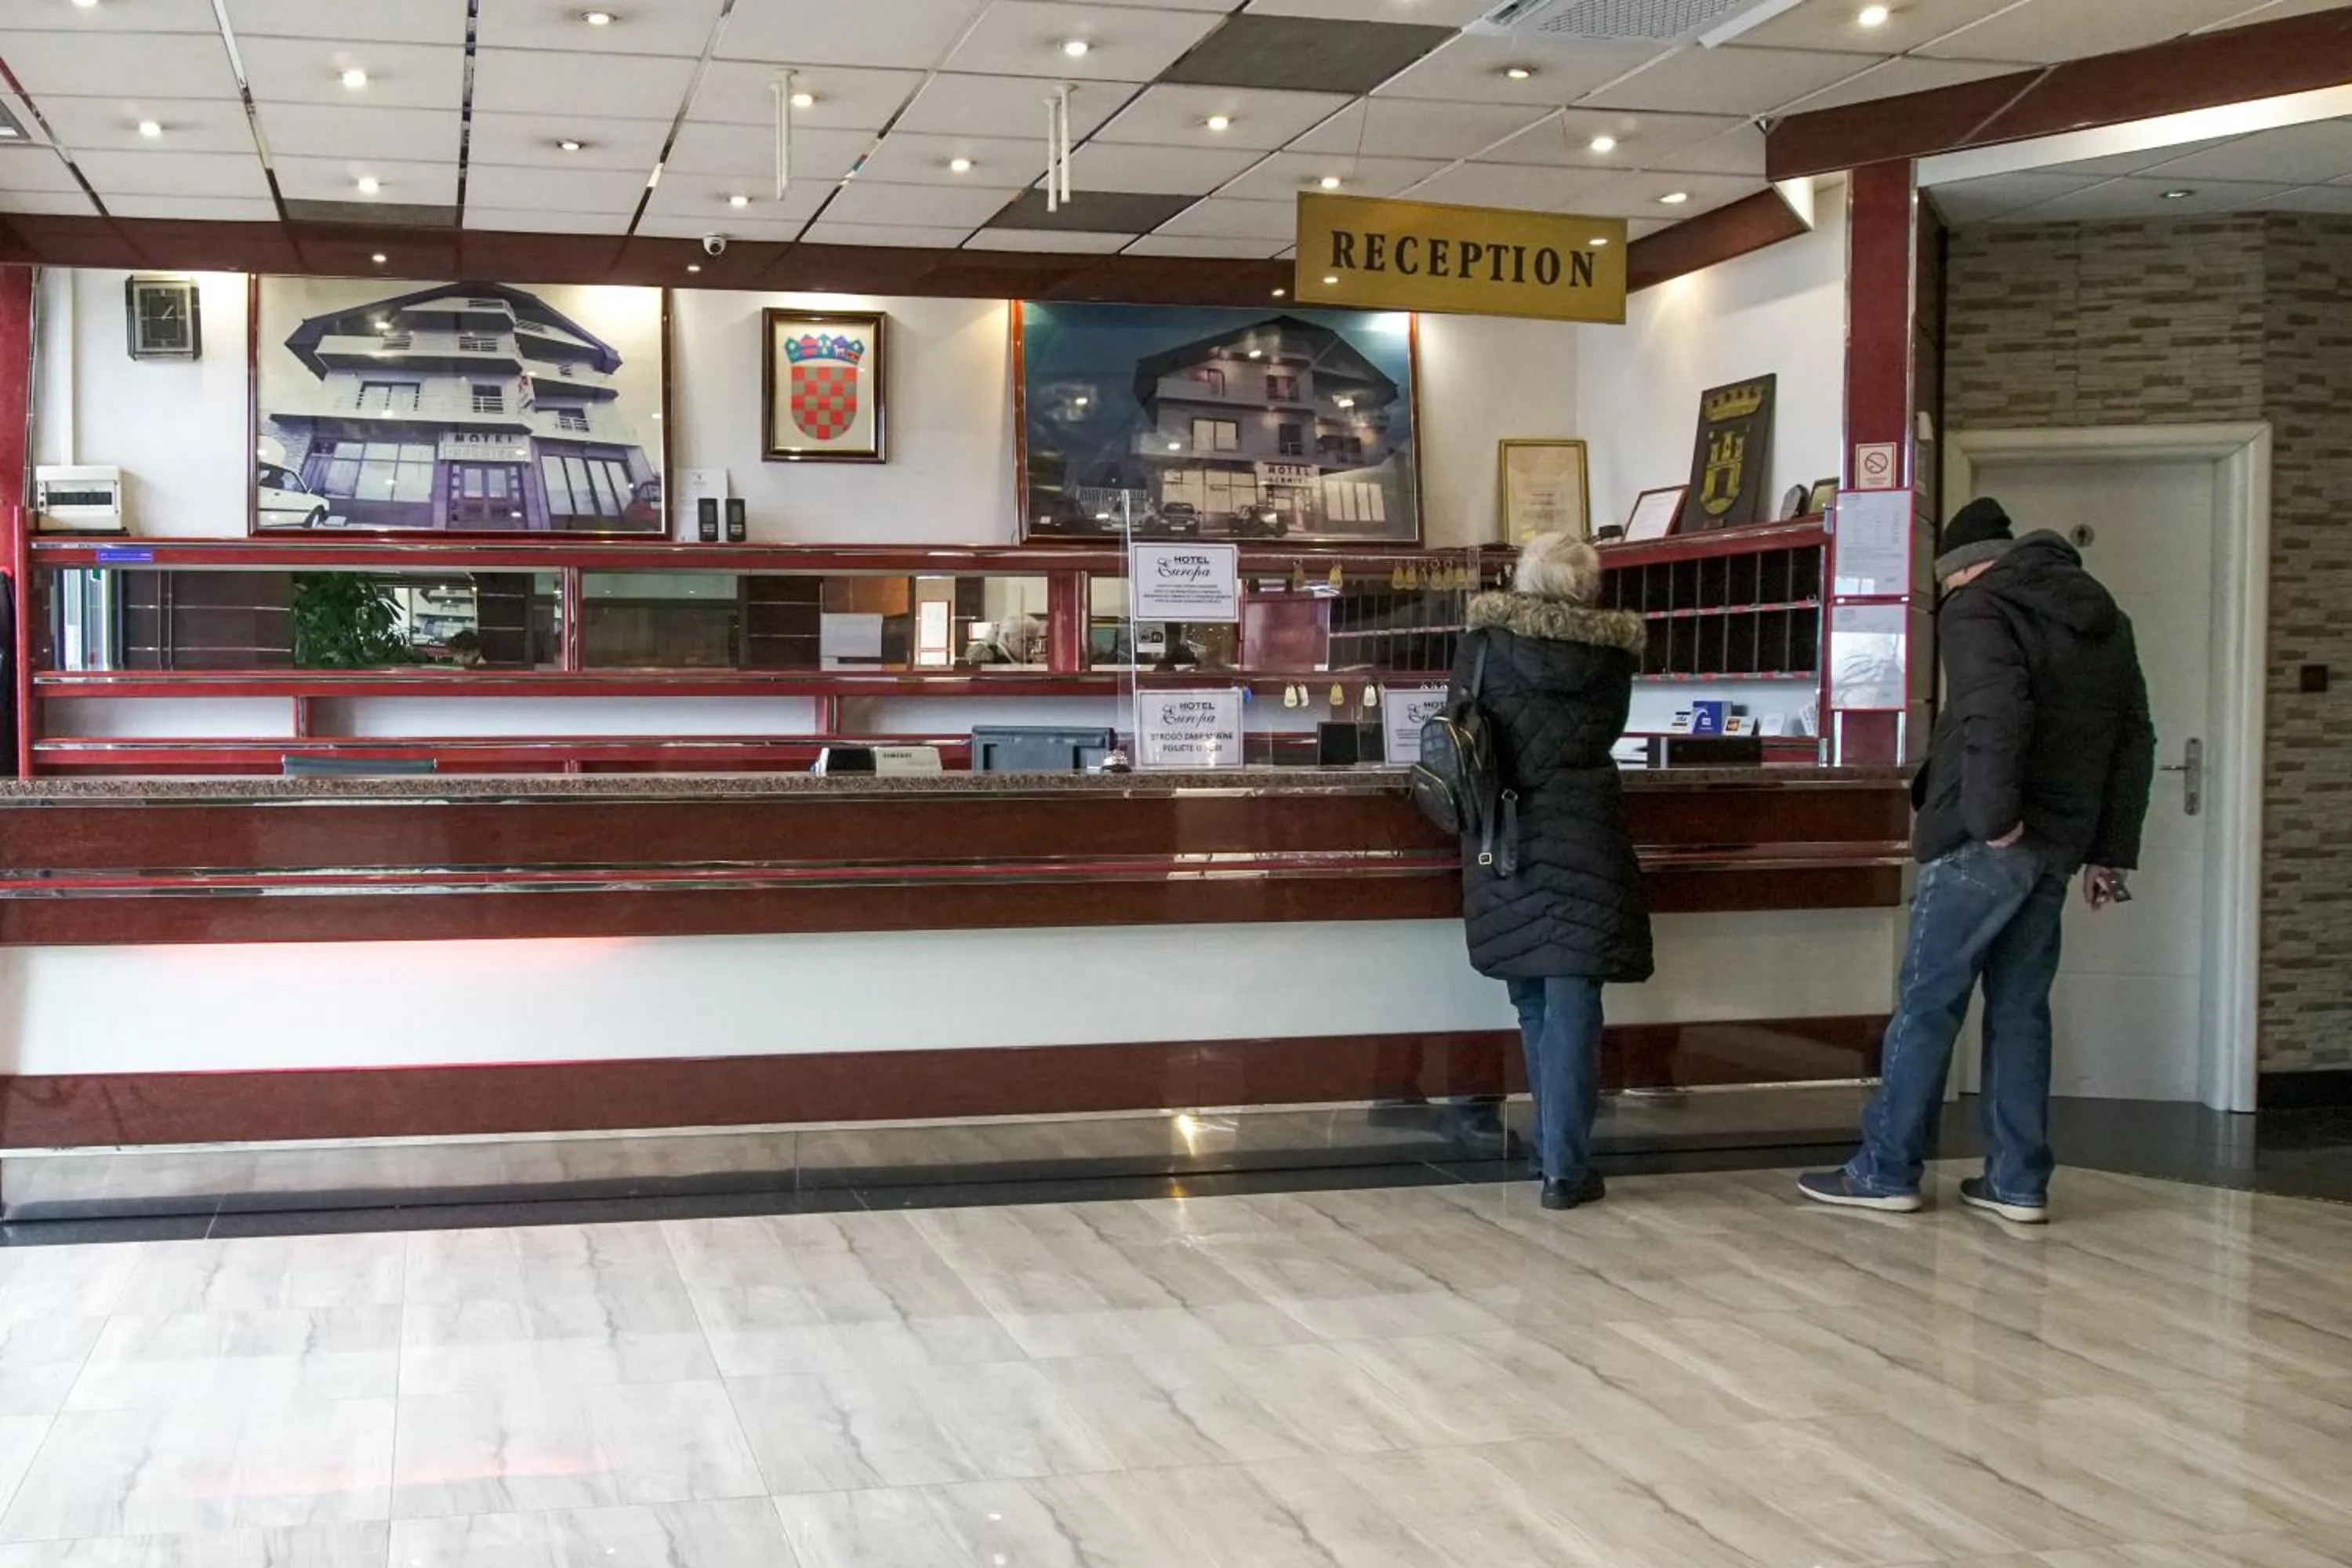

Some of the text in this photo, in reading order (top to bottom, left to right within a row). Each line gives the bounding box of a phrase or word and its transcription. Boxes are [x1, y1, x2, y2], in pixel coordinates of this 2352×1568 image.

[1330, 230, 1596, 288] RECEPTION
[1156, 557, 1211, 582] Europa
[1174, 556, 1210, 564] HOTEL
[1162, 705, 1216, 728] Europa
[1179, 702, 1216, 710] HOTEL
